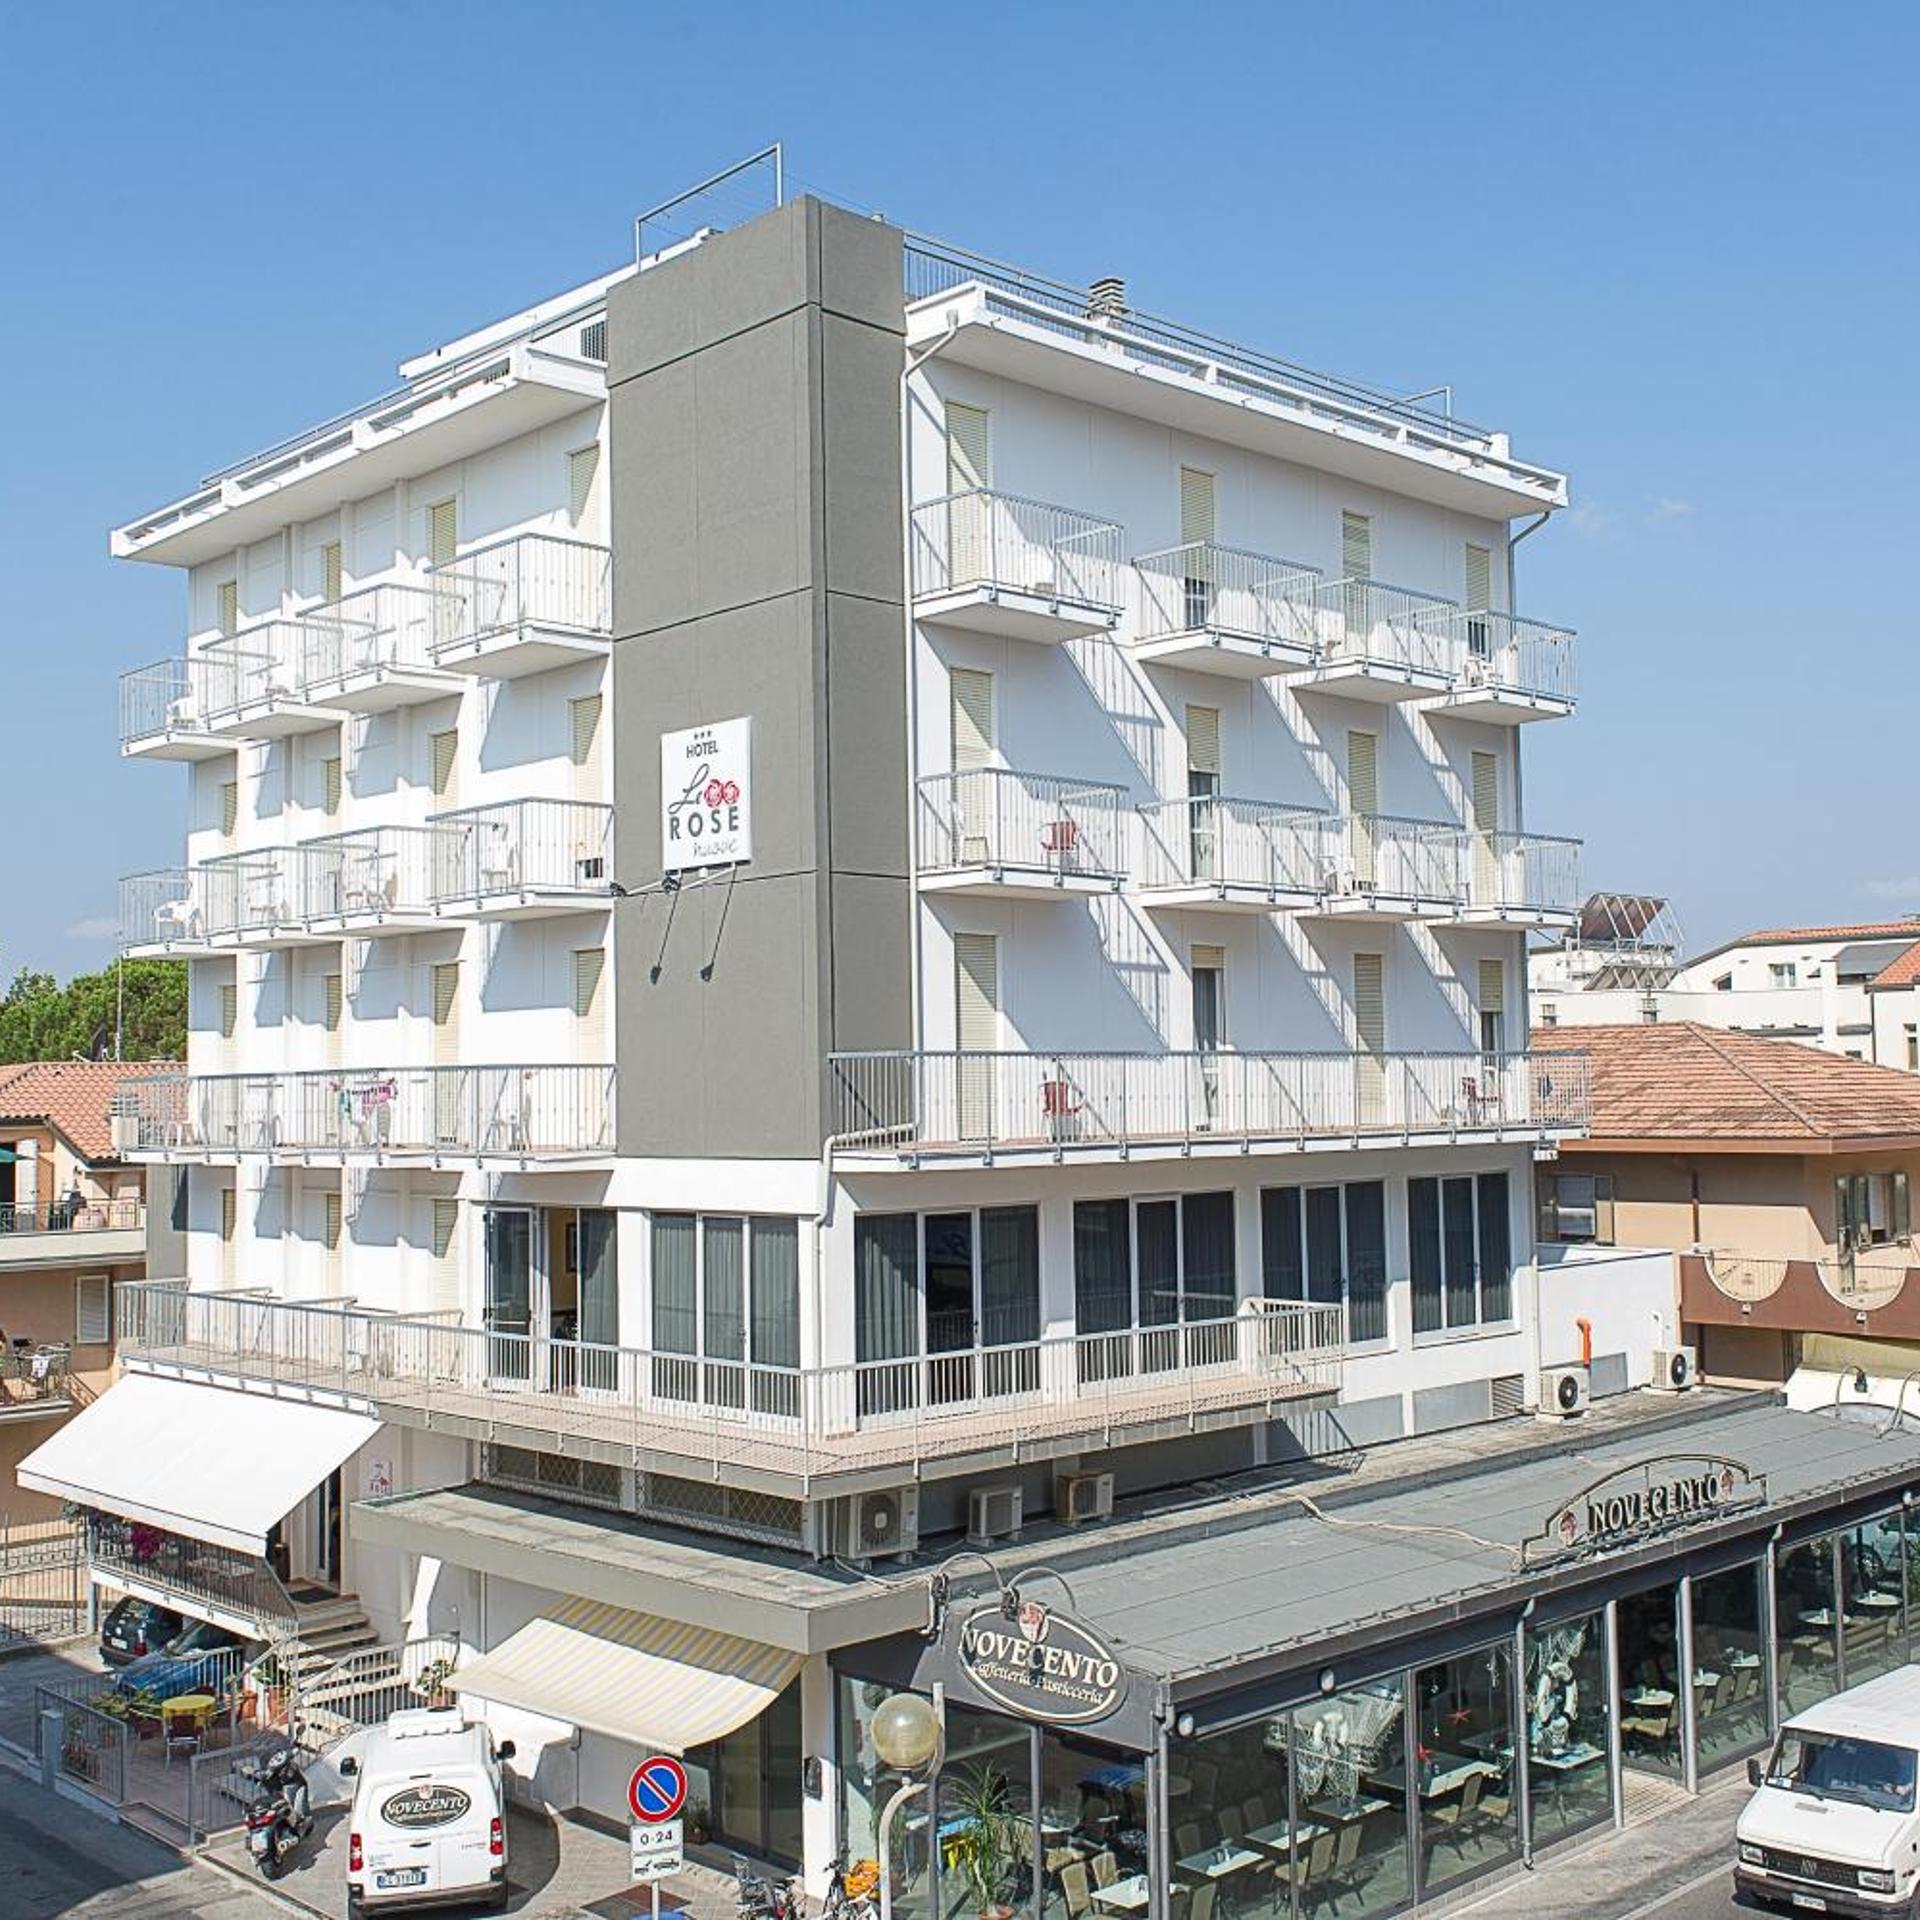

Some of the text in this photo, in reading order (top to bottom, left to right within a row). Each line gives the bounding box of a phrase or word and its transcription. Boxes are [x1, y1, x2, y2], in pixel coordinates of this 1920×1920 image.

[686, 740, 719, 758] HOTEL
[669, 805, 739, 841] ROSE
[1591, 1474, 1719, 1535] NOVECENTO
[964, 1628, 1119, 1688] NOVECENTO
[386, 1796, 468, 1816] NOVECENTO
